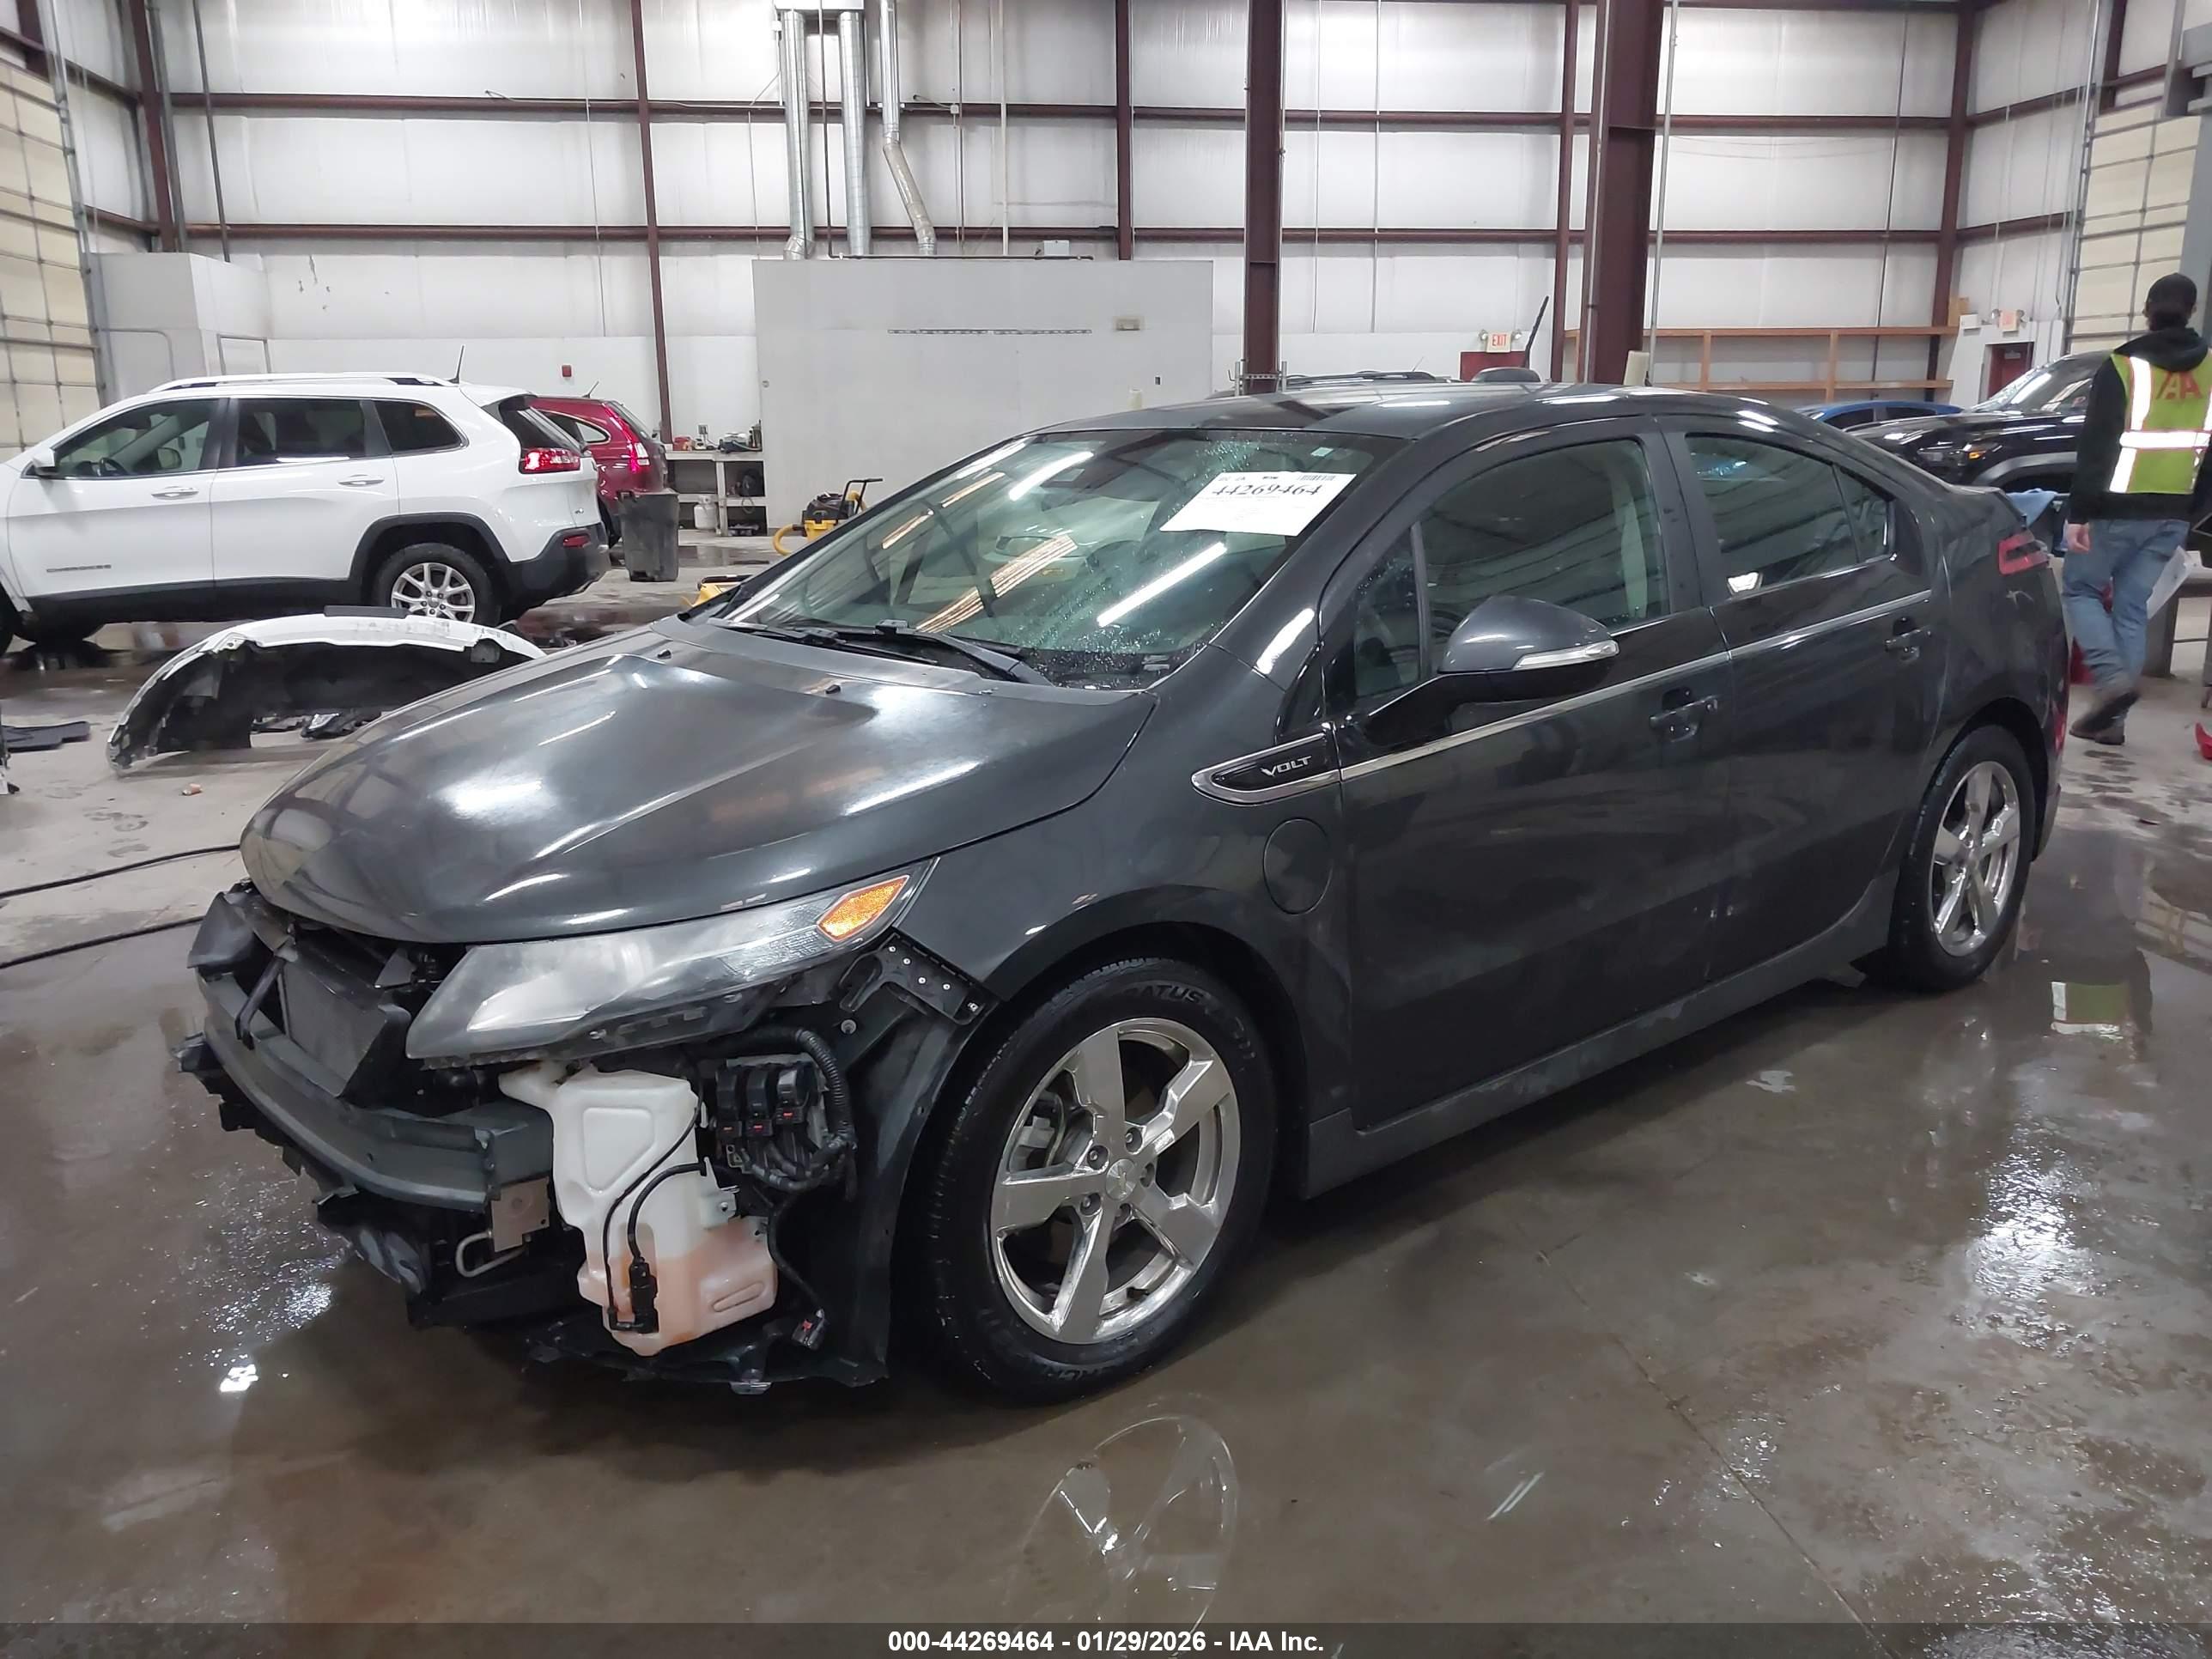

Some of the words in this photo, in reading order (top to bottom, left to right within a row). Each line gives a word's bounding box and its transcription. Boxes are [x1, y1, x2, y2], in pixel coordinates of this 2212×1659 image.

[1492, 333, 1508, 347] EXIT
[1212, 483, 1324, 496] 44269464
[1260, 755, 1312, 777] VOLT
